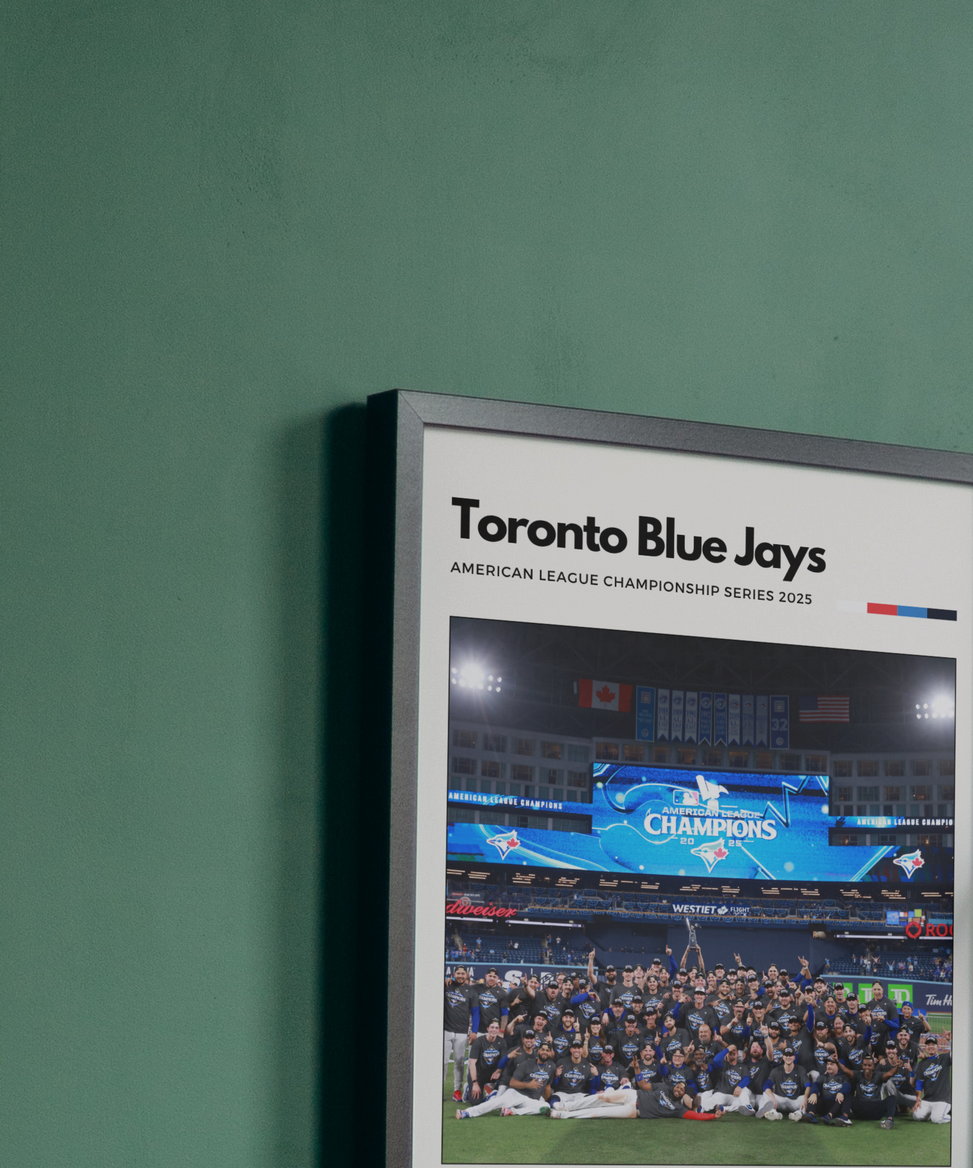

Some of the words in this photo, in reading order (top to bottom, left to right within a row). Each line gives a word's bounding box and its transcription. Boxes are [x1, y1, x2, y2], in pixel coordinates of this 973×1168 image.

[451, 496, 628, 554] Toronto
[637, 515, 728, 564] Blue
[733, 526, 827, 583] Jays
[450, 561, 534, 580] AMERICAN
[539, 569, 599, 586] LEAGUE
[603, 575, 720, 597] CHAMPIONSHIP
[724, 586, 774, 602] SERIES
[778, 591, 812, 605] 2025
[771, 718, 788, 731] 32
[448, 792, 487, 802] AMERICAN
[490, 797, 518, 806] LEAGUE
[520, 799, 563, 810] CHAMPIONS
[661, 806, 719, 817] AMERICAN
[721, 809, 760, 819] LEAGUE
[643, 813, 778, 840] CHAMPIONS
[857, 818, 892, 826] AMERICAN
[893, 818, 920, 826] LEAGUE
[680, 837, 695, 845] 20
[728, 839, 742, 847] 25
[890, 988, 911, 1004] TD
[925, 993, 942, 1006] Tim
